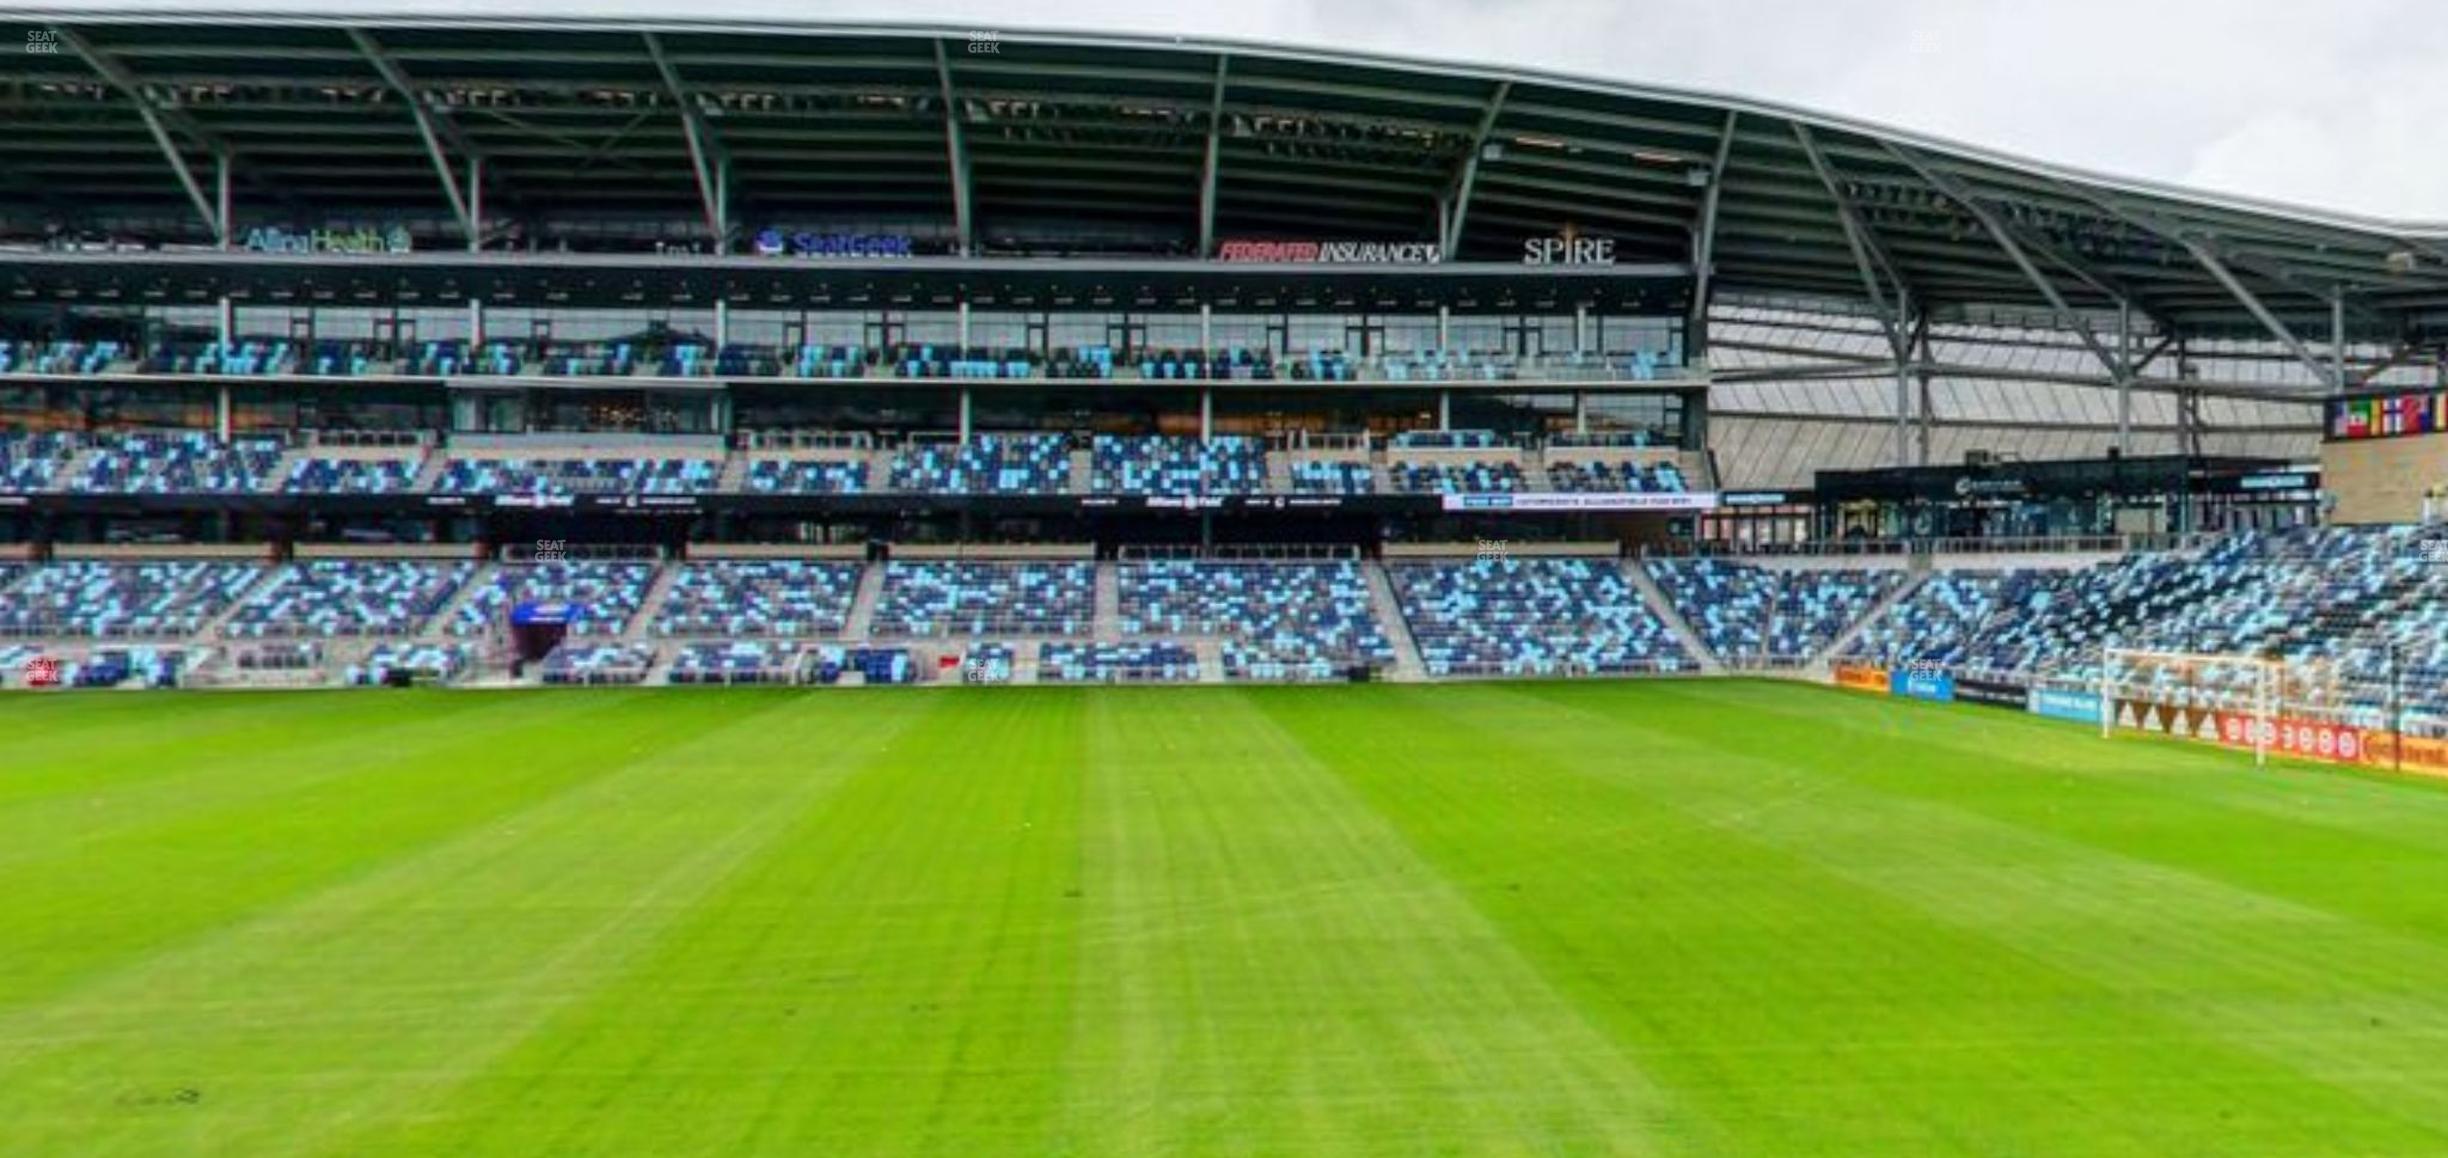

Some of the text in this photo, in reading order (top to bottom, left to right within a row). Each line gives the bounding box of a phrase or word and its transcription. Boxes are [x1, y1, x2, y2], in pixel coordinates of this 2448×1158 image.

[793, 232, 911, 257] SeatGeek
[1220, 241, 1423, 262] FEDERATED INSURANCE
[1524, 231, 1616, 265] SPIRE
